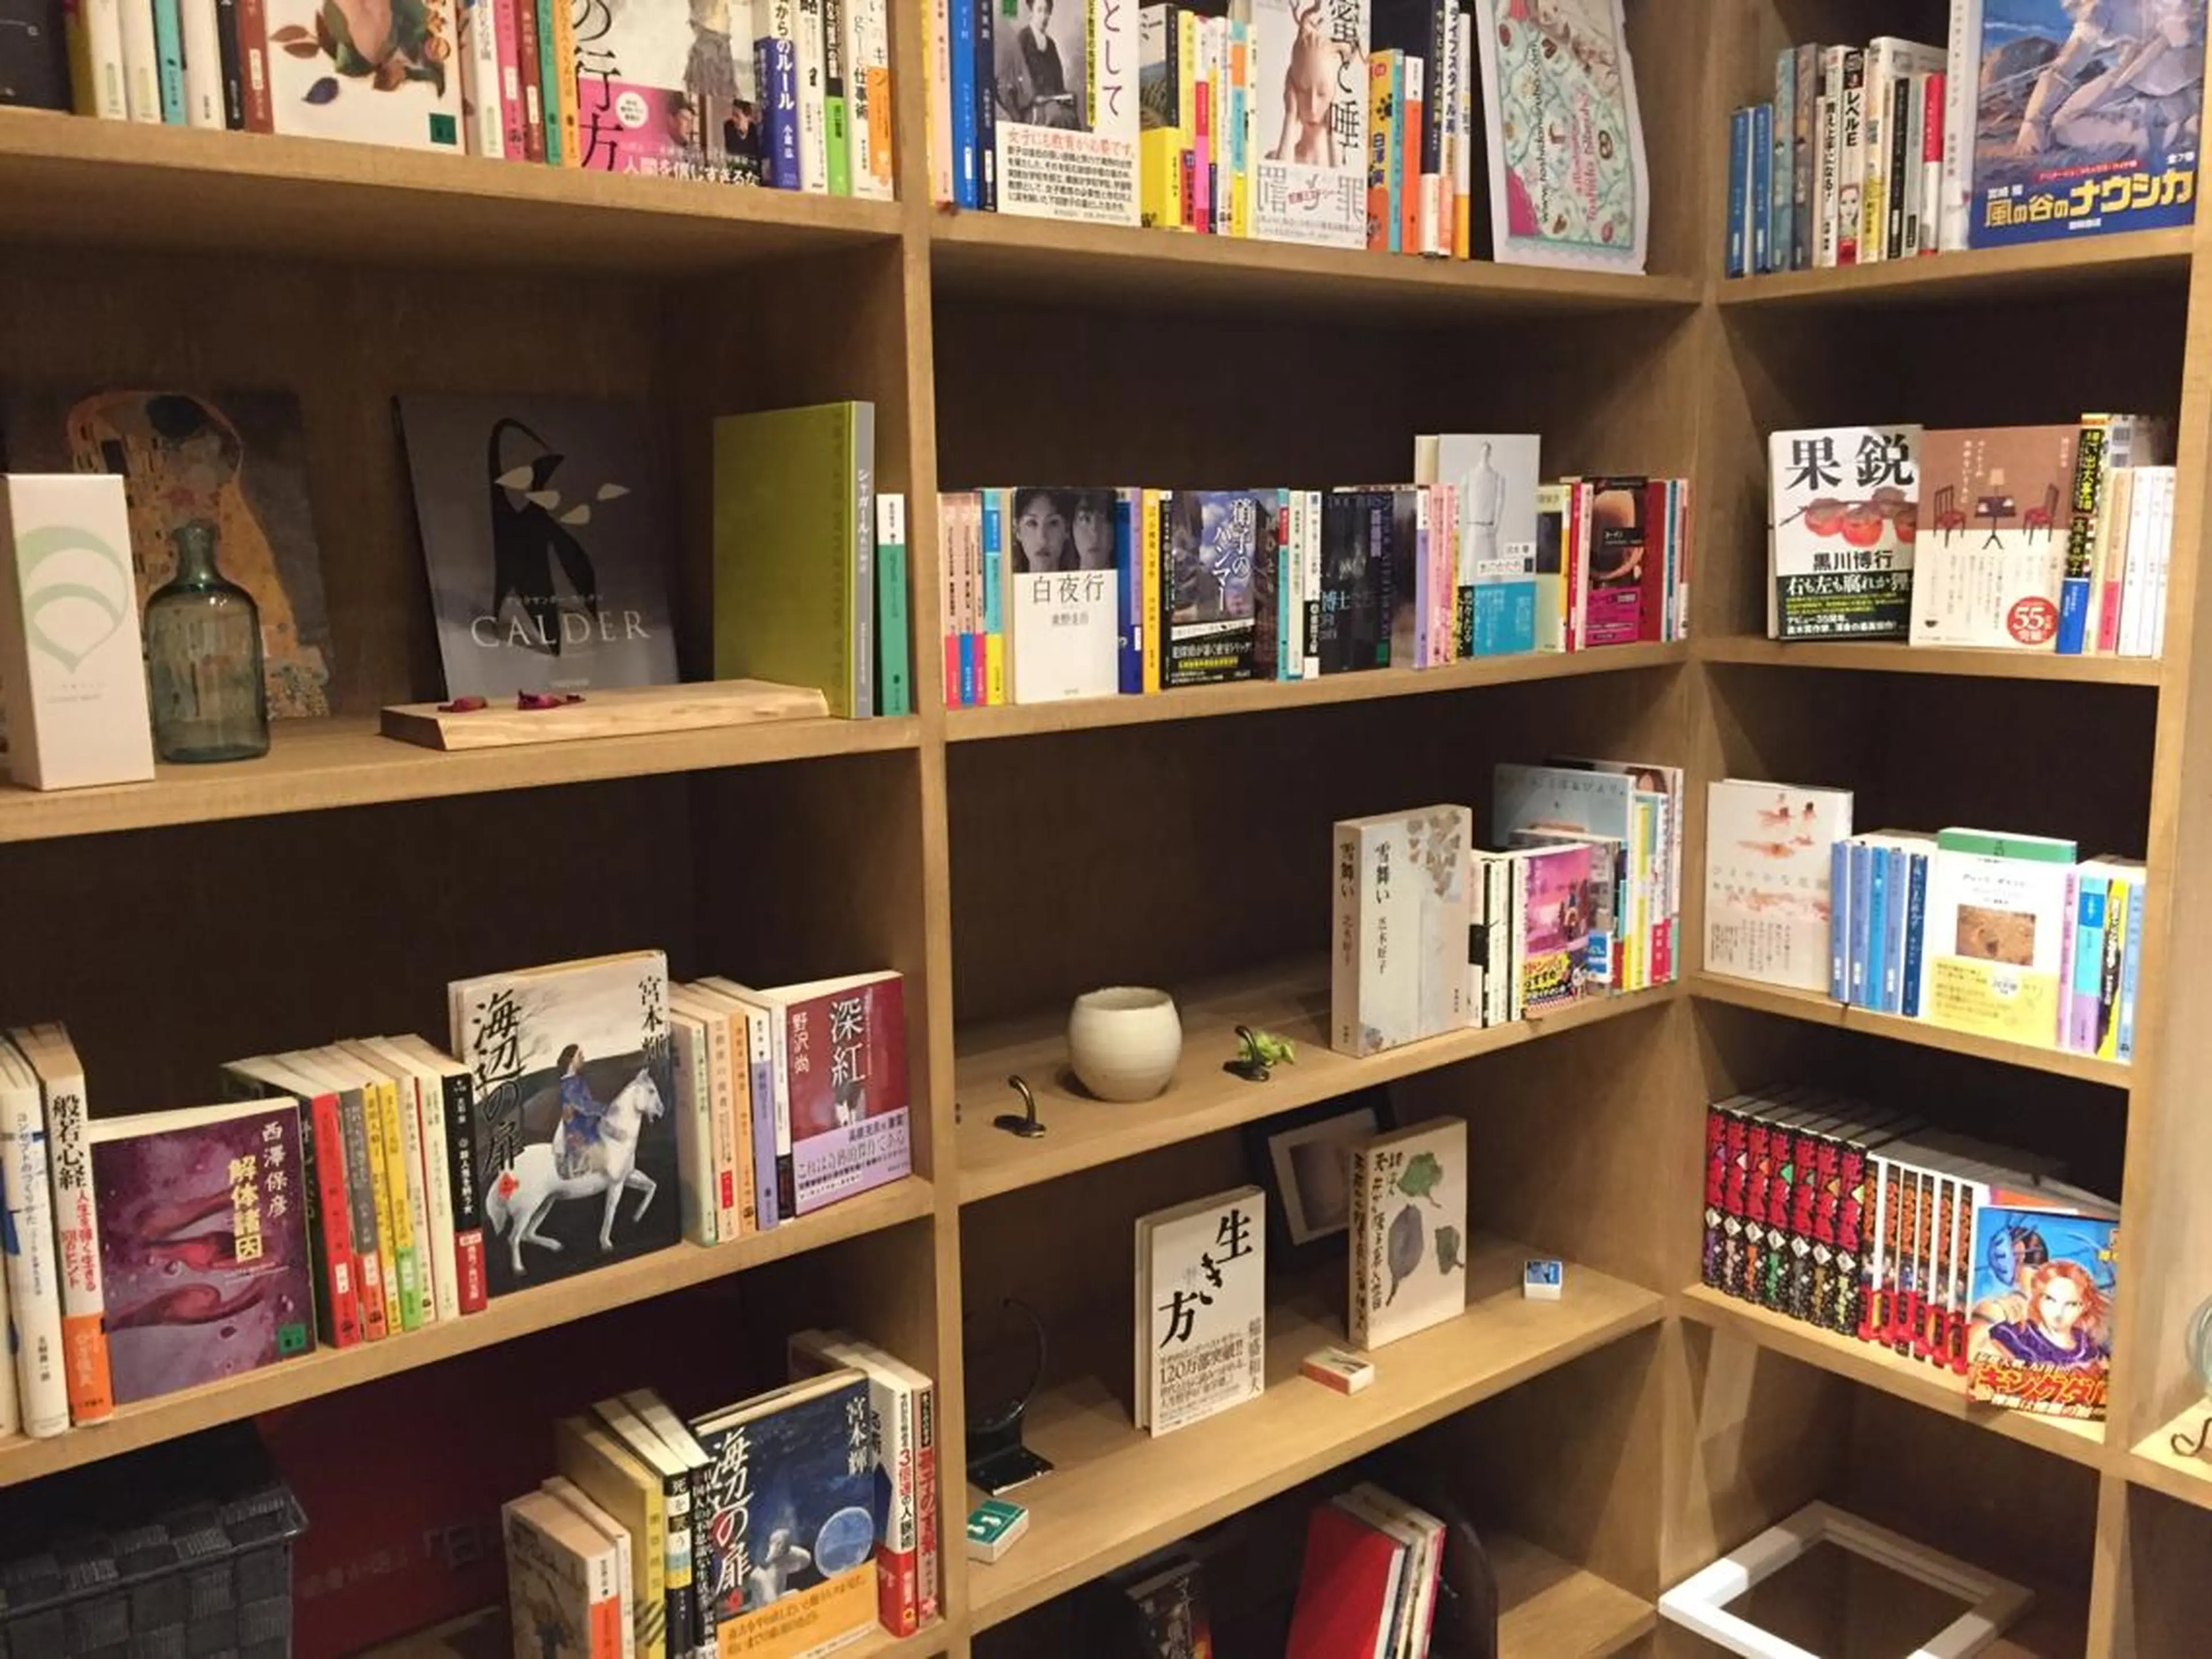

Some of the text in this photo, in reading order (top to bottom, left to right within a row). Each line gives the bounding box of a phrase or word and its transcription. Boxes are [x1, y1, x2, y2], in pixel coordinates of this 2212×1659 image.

[1845, 90, 1861, 146] レベルE
[1985, 168, 2194, 228] 風の谷のナウシカ
[1785, 435, 1914, 491] 果鋭
[1033, 573, 1105, 603] 白夜行
[1813, 550, 1893, 571] 黒川博行
[471, 609, 652, 647] CALDER
[472, 988, 528, 1173] 海辺の扉
[792, 1012, 810, 1073] 野沢尚
[828, 997, 865, 1087] 深紅
[51, 1094, 88, 1192] 般若心経
[262, 1121, 289, 1219] 西澤保彦
[76, 1190, 96, 1292] 人生を強く生きる
[229, 1153, 263, 1263] 解体諸因
[1158, 1208, 1253, 1350] 生き方
[845, 1395, 869, 1476] 宮本輝
